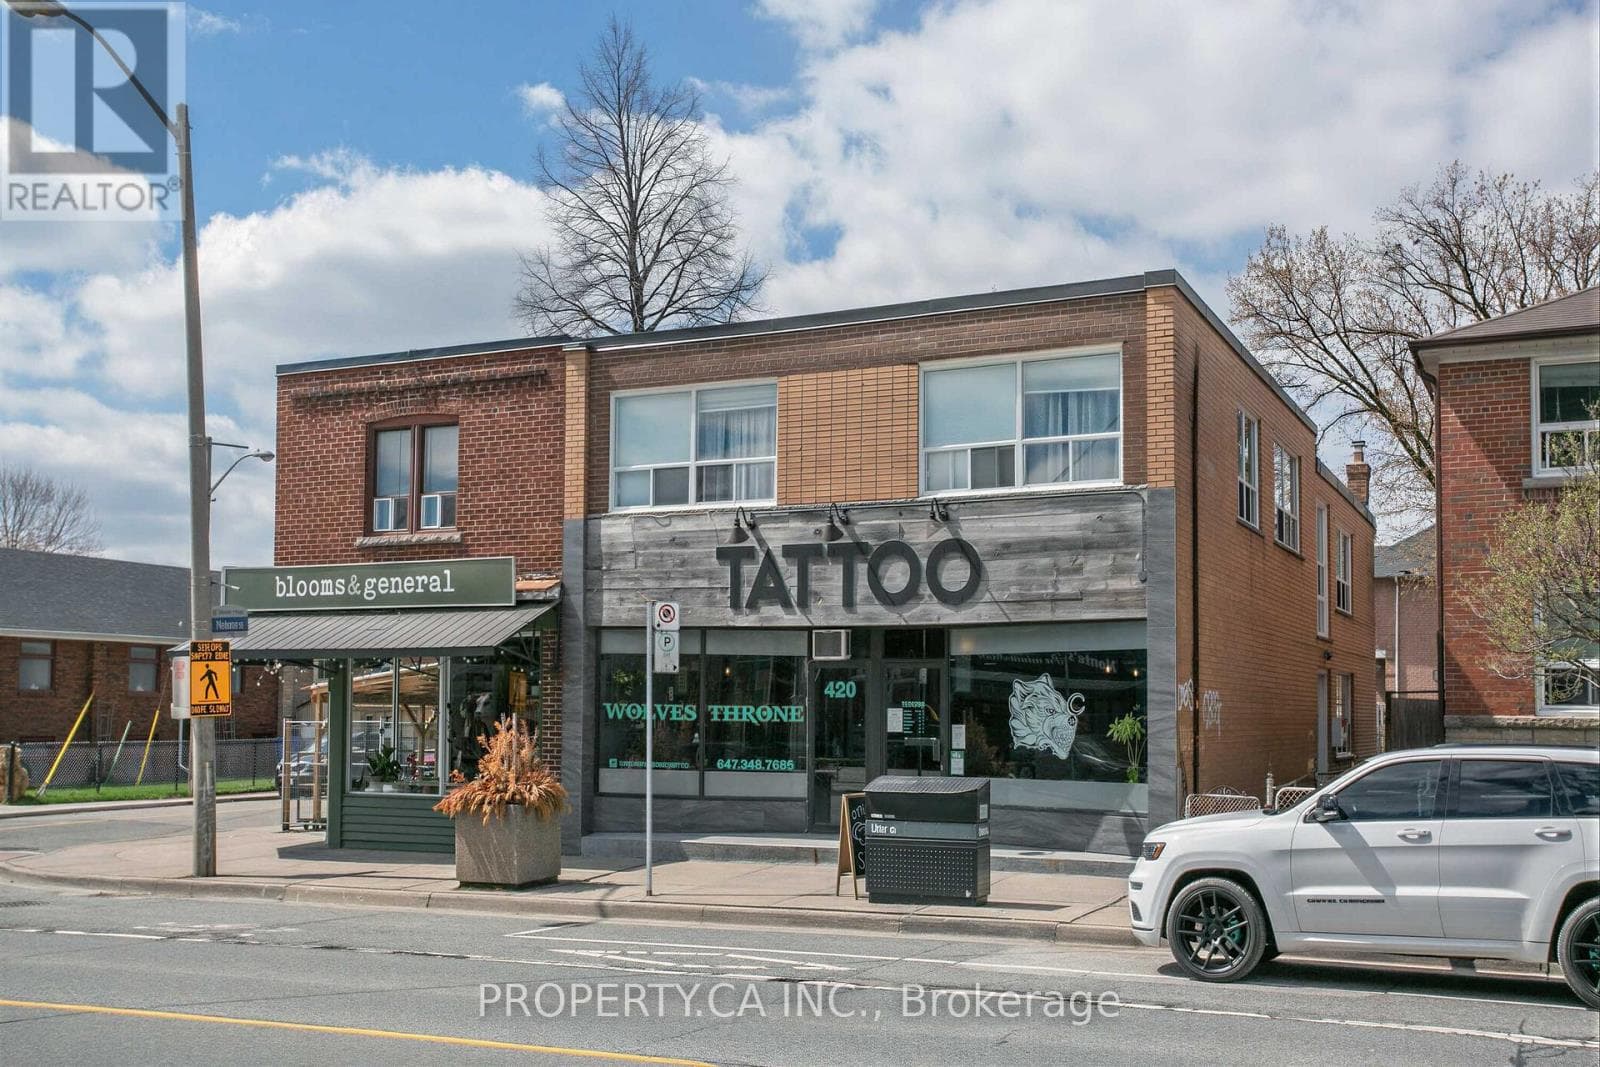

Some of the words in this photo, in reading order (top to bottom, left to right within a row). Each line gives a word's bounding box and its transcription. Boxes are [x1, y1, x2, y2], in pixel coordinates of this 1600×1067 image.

[715, 537, 982, 610] TATTOO
[664, 636, 671, 647] P
[823, 680, 857, 699] 420
[602, 702, 698, 722] WOLVES
[707, 704, 805, 726] THRONE
[716, 759, 795, 770] 647.348.7685
